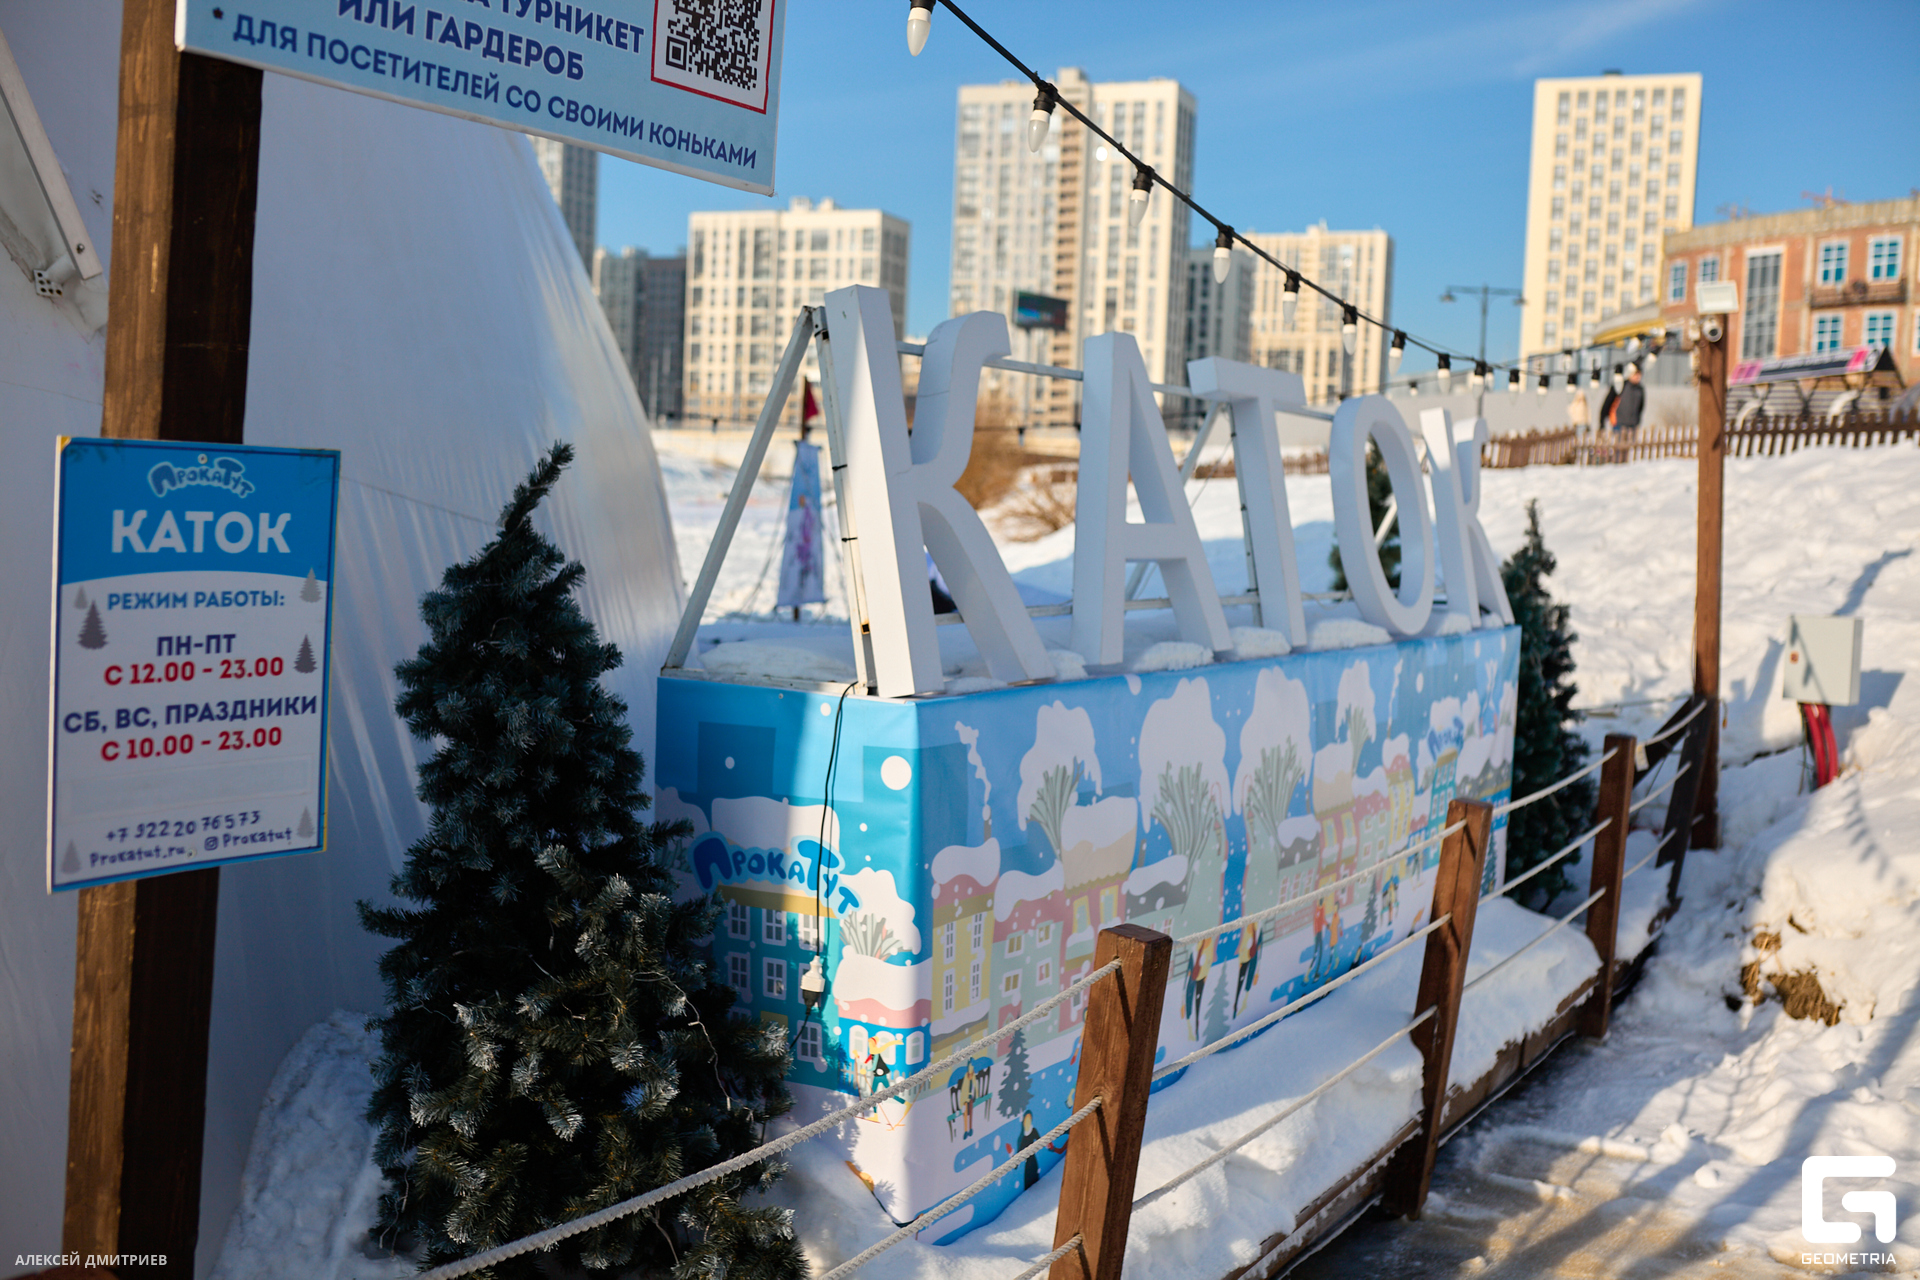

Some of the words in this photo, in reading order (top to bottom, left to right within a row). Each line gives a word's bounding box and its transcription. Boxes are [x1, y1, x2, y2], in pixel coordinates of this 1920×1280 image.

[425, 9, 584, 81] ГАРДЕРОБ
[233, 14, 297, 52] ДЛЯ
[307, 32, 499, 103] ПОСЕТИТЕЛЕЙ
[506, 85, 541, 112] СО
[548, 96, 643, 140] СВОИМИ
[649, 122, 757, 169] КОНЬКАМИ
[824, 284, 1516, 698] КАТОК
[111, 509, 292, 553] КАТОК
[107, 592, 187, 611] РЕЖИМ
[194, 590, 285, 608] РАБОТЫ:
[156, 633, 236, 656] ПН-ПТ
[104, 665, 123, 686] С
[129, 661, 195, 685] 12.00
[219, 656, 284, 679] 23.00
[63, 711, 107, 733] СБ,
[115, 706, 157, 729] ВС,
[165, 695, 317, 725] ПРАЗДНИКИ
[101, 741, 120, 761] С
[126, 733, 194, 760] 10.00
[217, 726, 282, 751] 23.00
